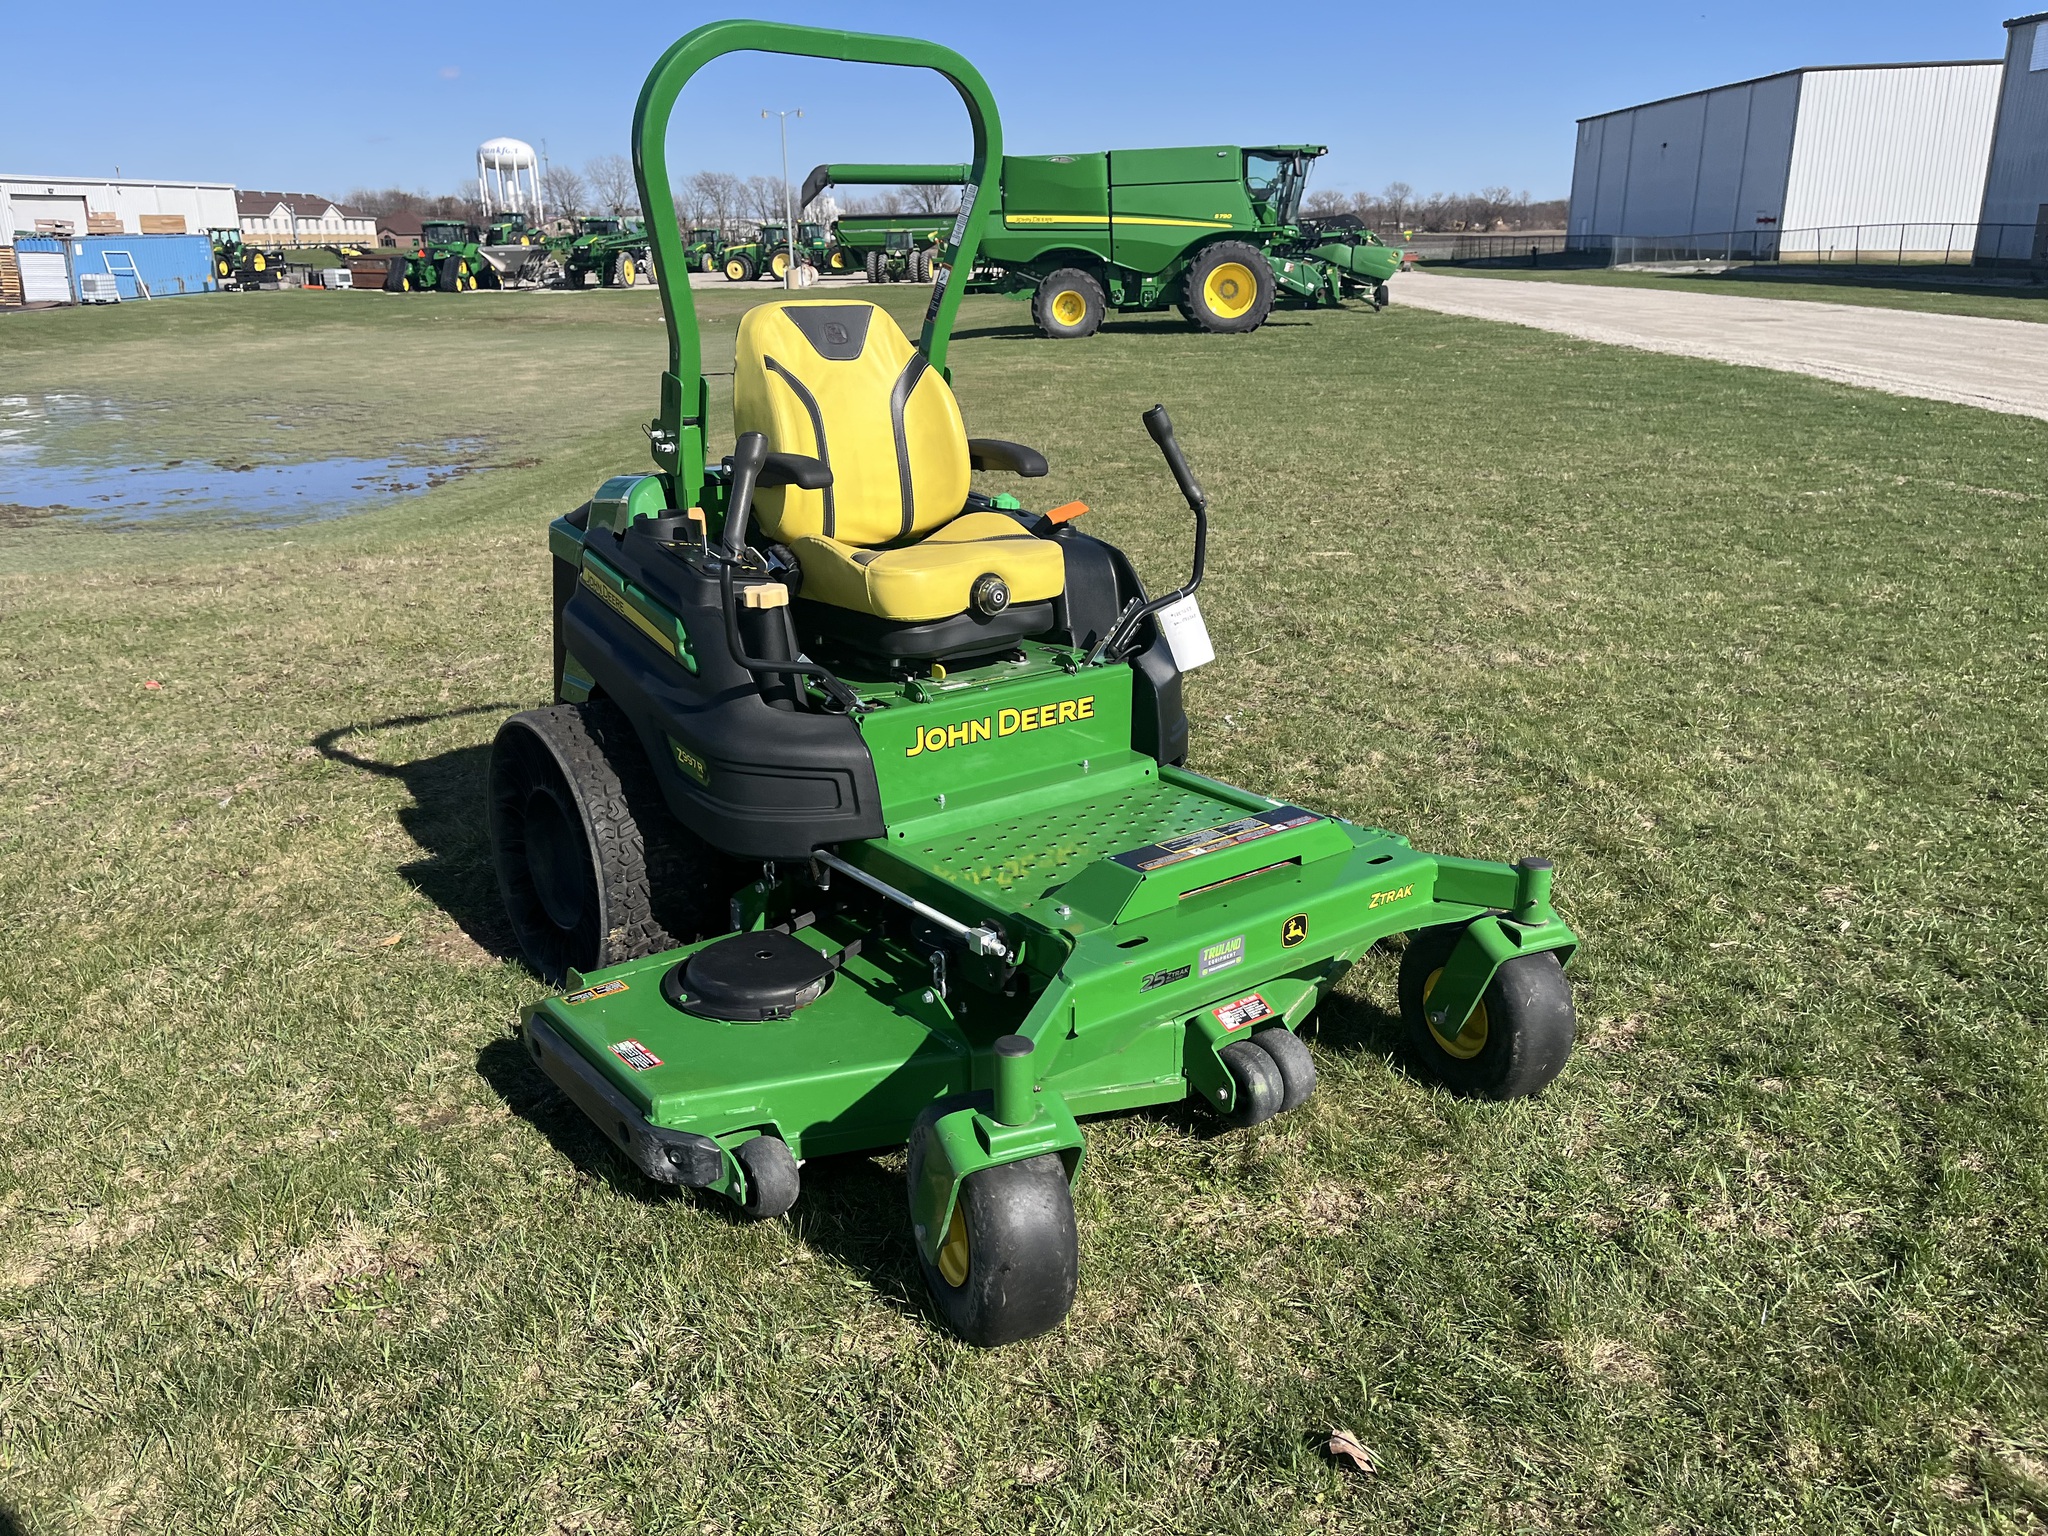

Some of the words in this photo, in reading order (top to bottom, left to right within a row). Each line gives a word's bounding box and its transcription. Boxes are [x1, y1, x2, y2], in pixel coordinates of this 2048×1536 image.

[586, 572, 605, 598] JOHN
[603, 585, 625, 614] DEERE
[906, 716, 991, 757] JOHN
[998, 695, 1095, 737] DEERE
[1368, 883, 1415, 910] ZTRAK
[1203, 937, 1242, 962] TRULAND
[1140, 969, 1168, 994] 25
[1167, 967, 1190, 980] ZTRAK
